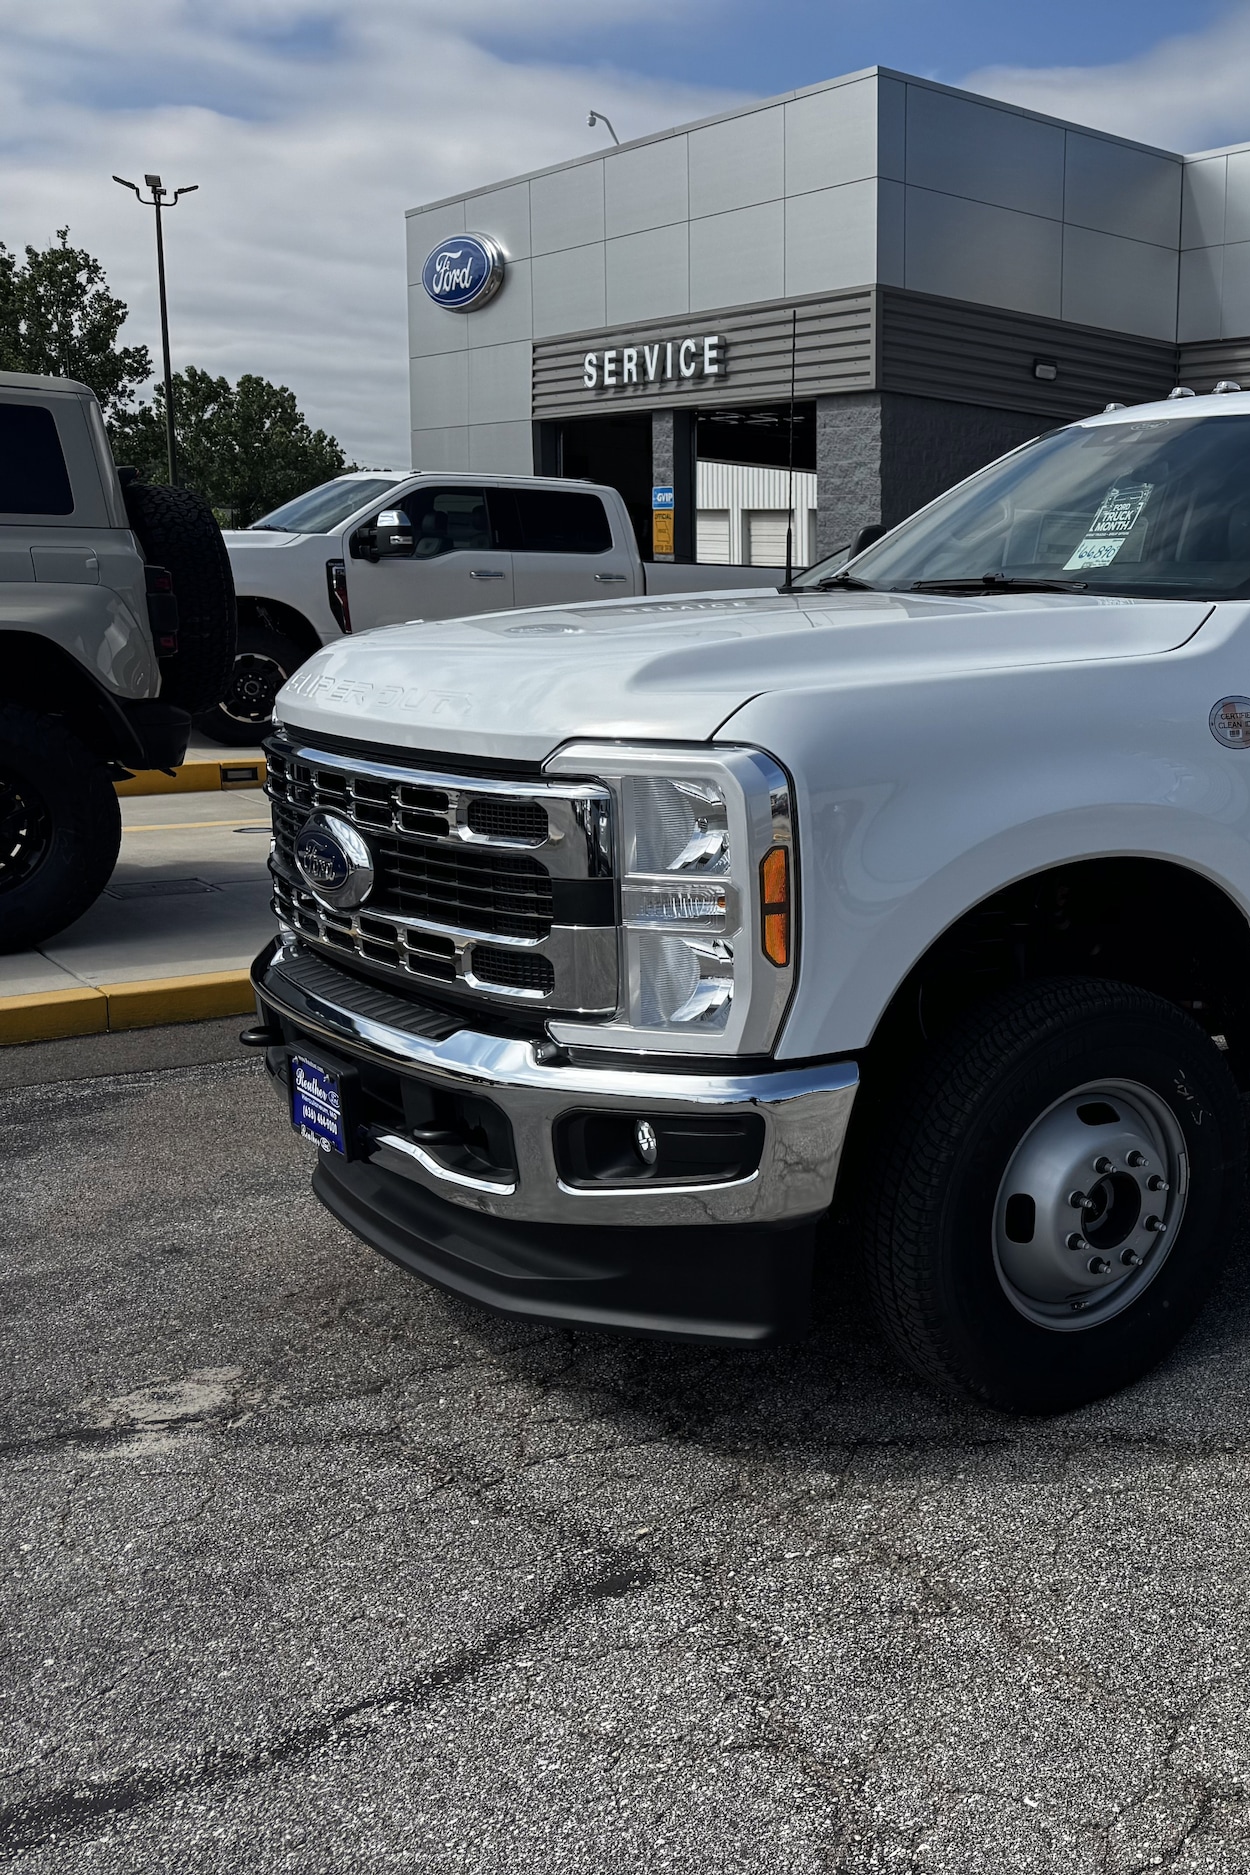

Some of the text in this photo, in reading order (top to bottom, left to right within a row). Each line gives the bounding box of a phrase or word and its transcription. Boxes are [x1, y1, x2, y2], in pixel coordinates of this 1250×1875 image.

[432, 250, 473, 295] Ford
[583, 335, 722, 389] SERVICE
[1094, 521, 1131, 532] MONTH
[1102, 510, 1134, 522] TRUCK
[286, 672, 374, 706] SUPER
[1218, 721, 1242, 729] CLEAN
[303, 839, 336, 881] Ford
